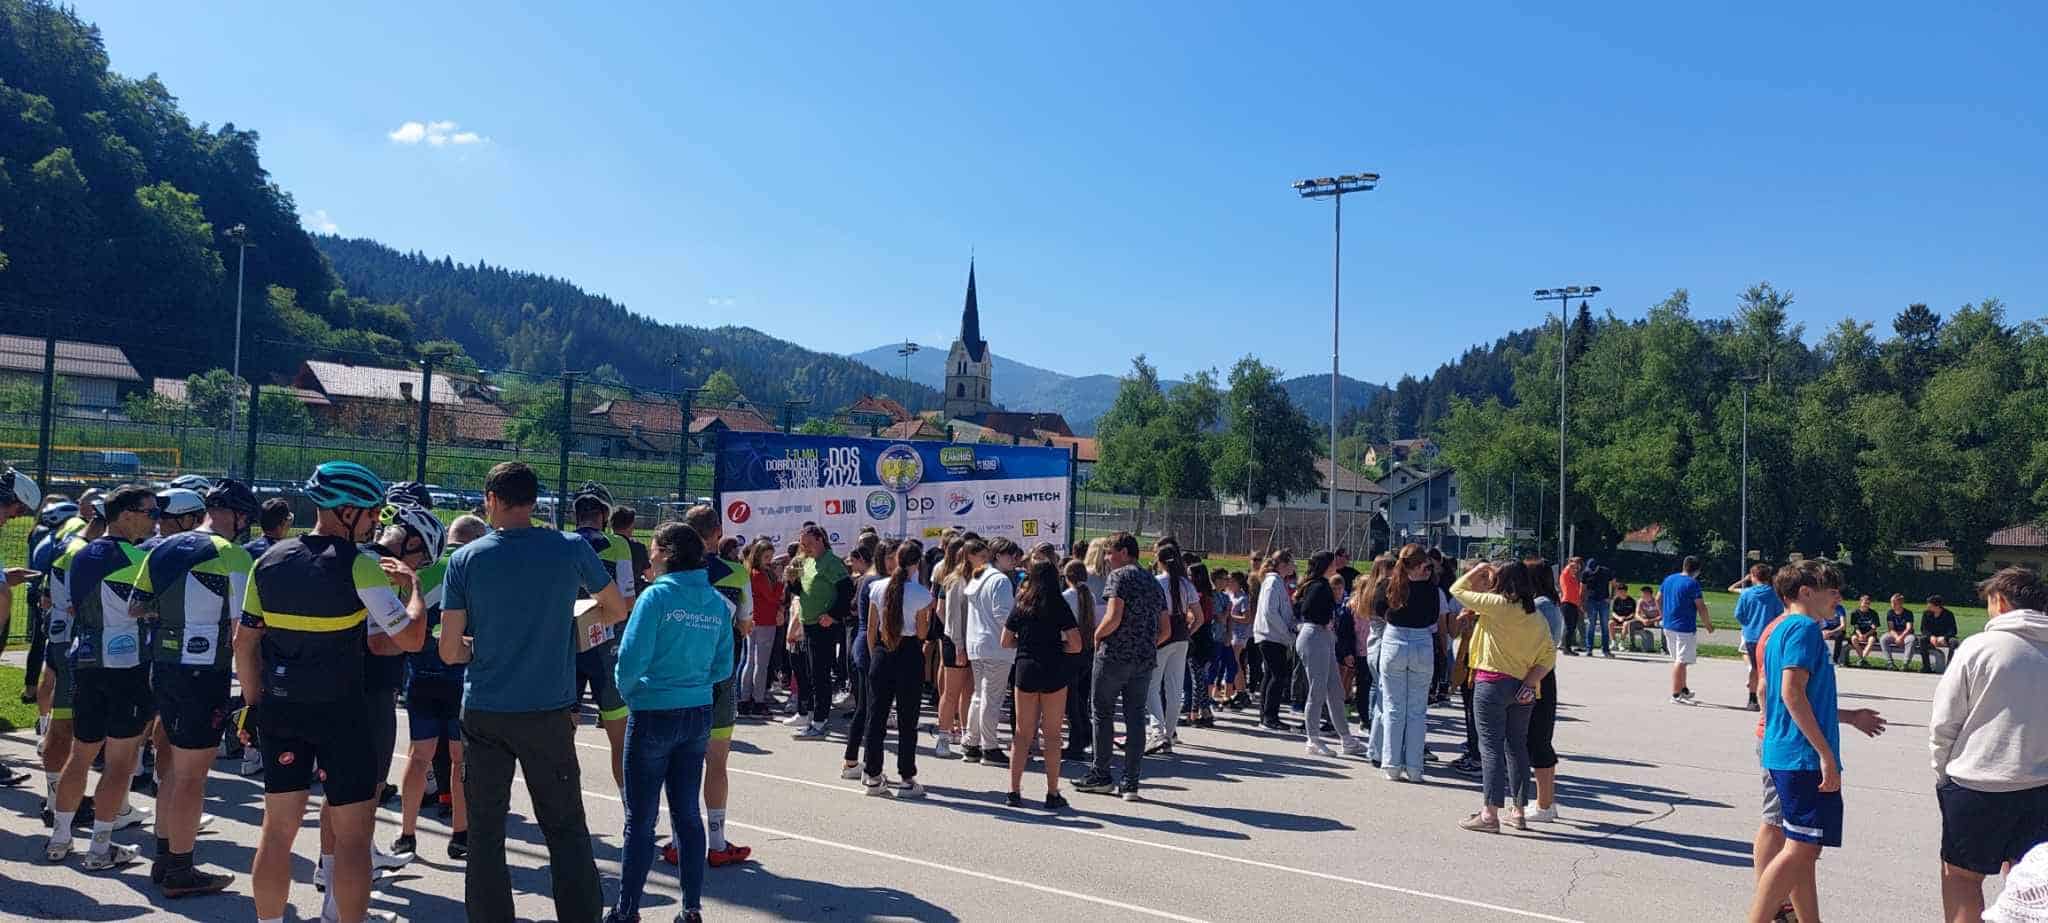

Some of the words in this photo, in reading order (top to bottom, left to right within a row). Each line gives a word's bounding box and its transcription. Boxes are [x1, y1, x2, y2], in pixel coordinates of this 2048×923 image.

[829, 446, 861, 469] DOS
[823, 467, 862, 488] 2024
[1003, 491, 1061, 504] FARMTECH
[841, 500, 857, 514] JUB
